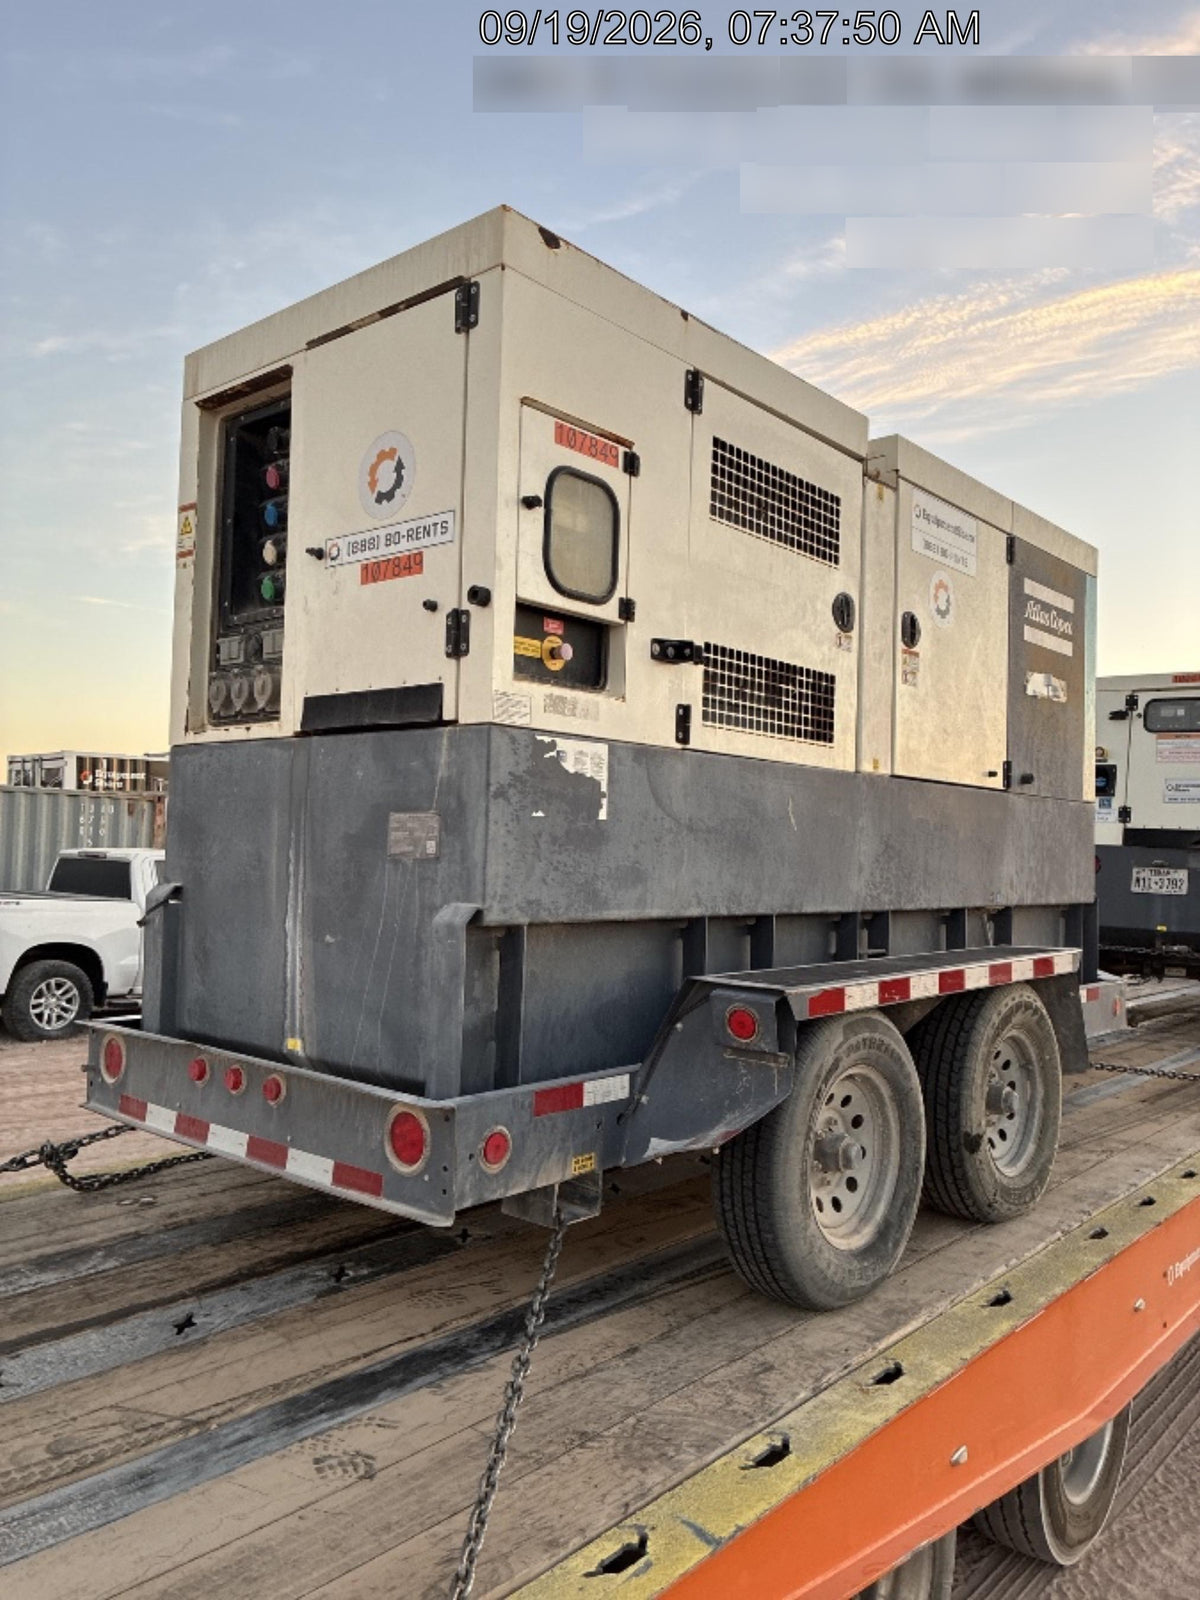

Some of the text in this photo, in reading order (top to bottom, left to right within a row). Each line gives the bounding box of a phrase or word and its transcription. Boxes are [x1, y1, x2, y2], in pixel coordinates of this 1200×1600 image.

[556, 422, 619, 466] 107849
[361, 551, 423, 583] 107849
[1023, 600, 1050, 627] Atlas
